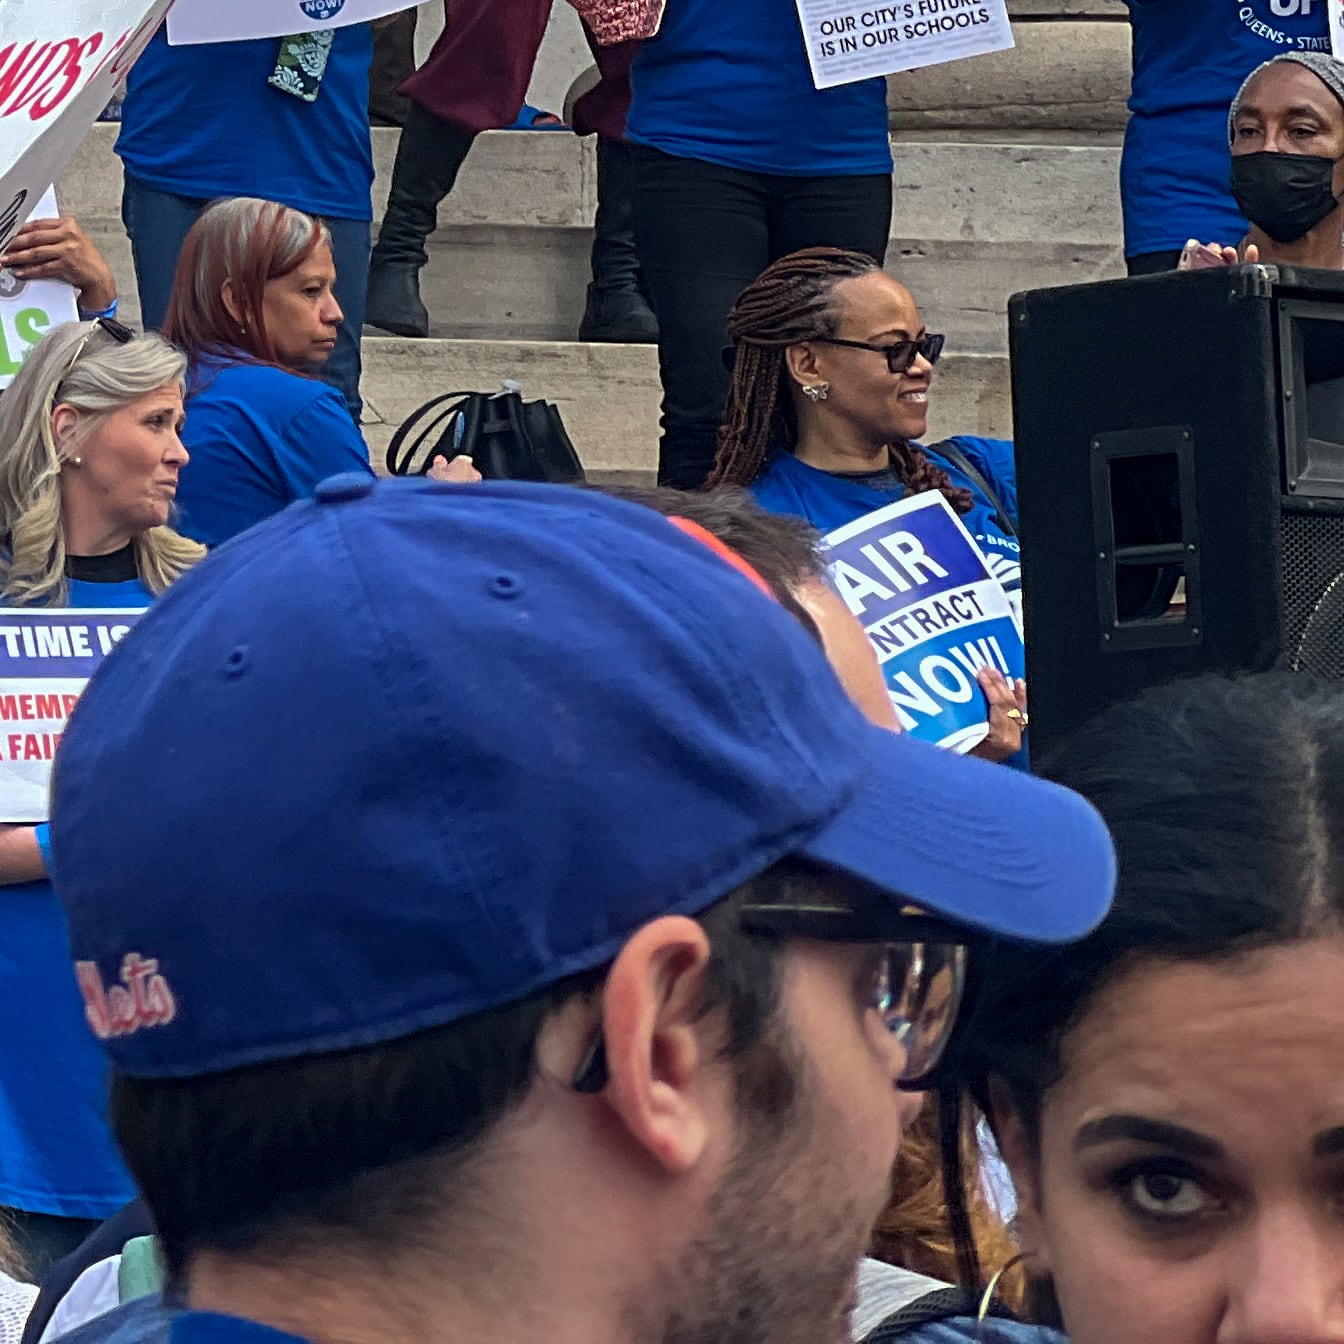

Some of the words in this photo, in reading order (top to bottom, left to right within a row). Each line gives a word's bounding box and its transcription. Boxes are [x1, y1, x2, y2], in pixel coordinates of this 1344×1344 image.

[820, 16, 857, 36] OUR
[860, 3, 915, 28] CITY'S
[820, 41, 836, 57] IS
[840, 35, 858, 54] IN
[862, 26, 901, 47] OUR
[903, 8, 990, 41] SCHOOLS
[1239, 7, 1285, 44] QUEENS
[1297, 36, 1330, 50] STATE
[832, 531, 950, 617] AIR
[868, 590, 986, 655] NTRACT
[889, 635, 1016, 731] NOW!
